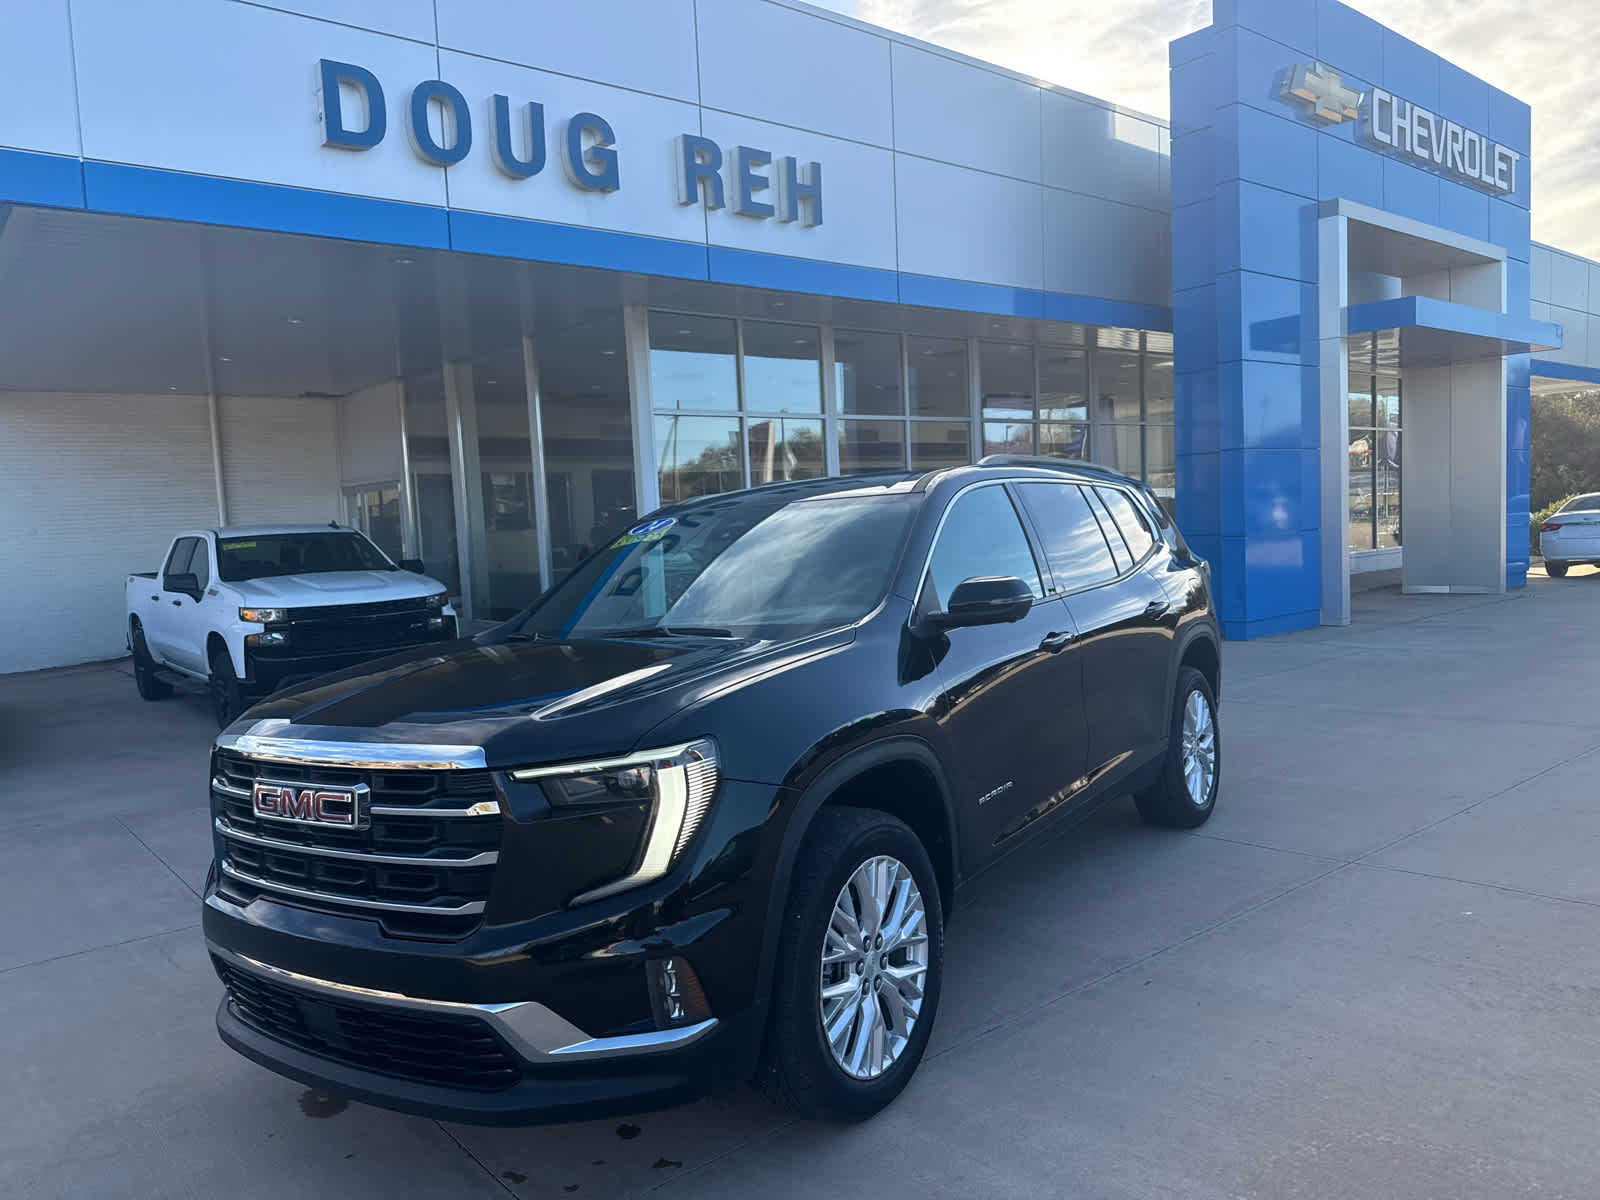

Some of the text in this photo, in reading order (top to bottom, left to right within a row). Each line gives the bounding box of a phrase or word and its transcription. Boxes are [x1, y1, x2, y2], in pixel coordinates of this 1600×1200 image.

[317, 58, 823, 229] DOUG REH
[1371, 87, 1520, 193] CHEVROLET
[253, 783, 353, 824] GMC
